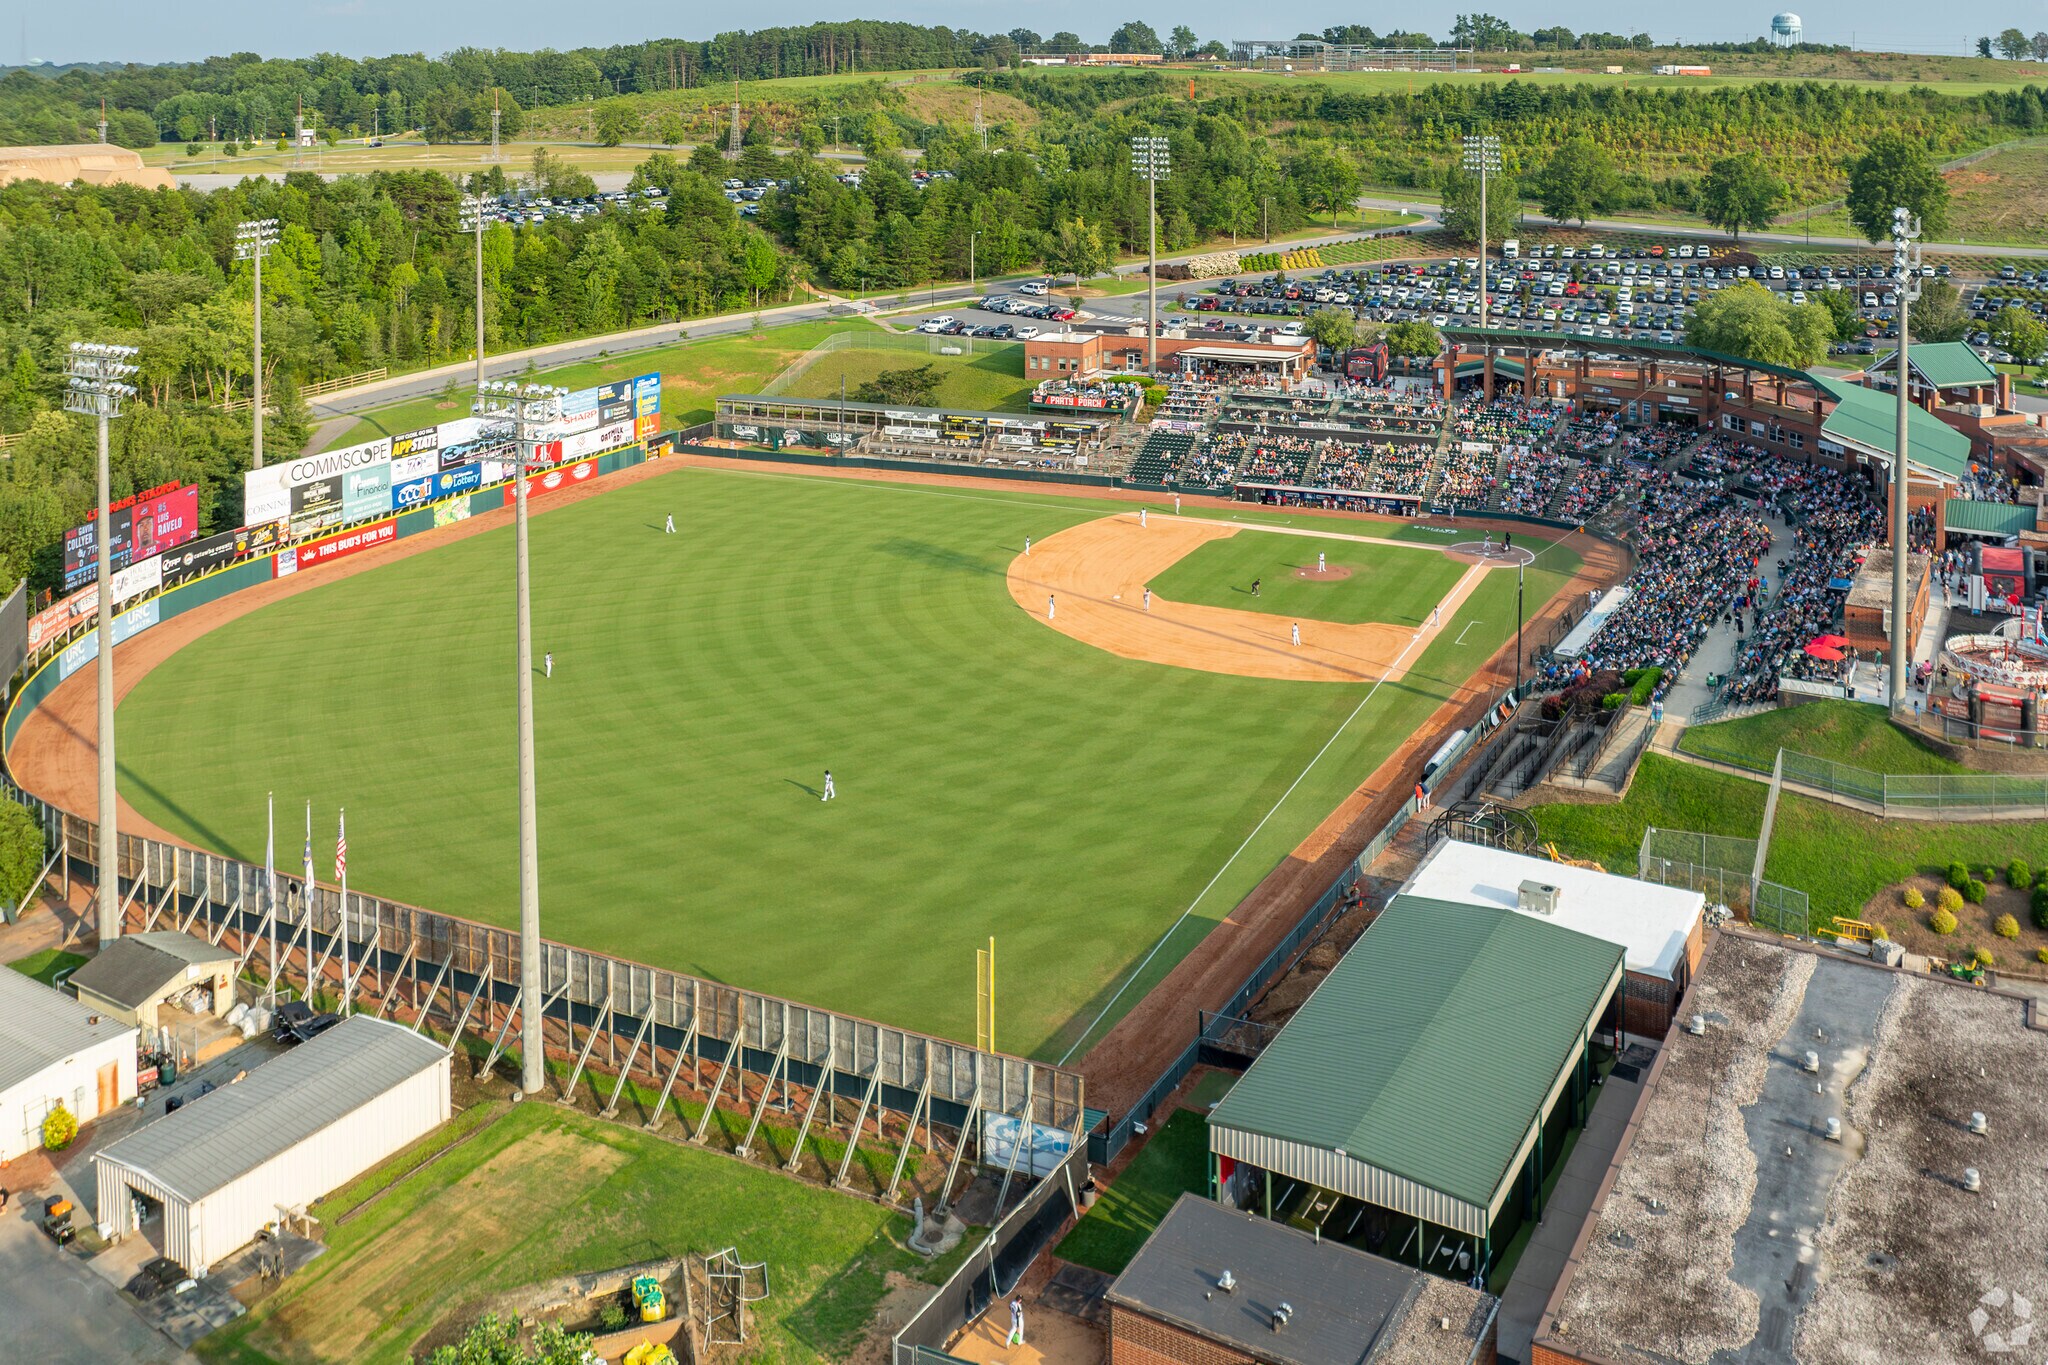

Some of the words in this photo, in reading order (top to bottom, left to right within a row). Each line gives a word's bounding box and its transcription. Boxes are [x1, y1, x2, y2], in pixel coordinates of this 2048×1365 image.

[1050, 396, 1074, 405] PARTY
[1078, 398, 1102, 407] PORCH
[563, 410, 597, 424] SHARP
[600, 426, 624, 442] OATMILK
[733, 424, 758, 433] HICKORY
[291, 442, 388, 481] COMMSCOPE
[453, 472, 480, 487] Lottery
[138, 480, 180, 502] STADIUM
[357, 481, 388, 497] Financial
[246, 498, 290, 517] CORNING
[158, 512, 169, 523] LUIS
[78, 523, 94, 535] GAVIN
[158, 517, 182, 536] RAVELO
[67, 533, 93, 551] COLLYER
[319, 542, 337, 557] THIS
[337, 535, 361, 552] BUD'S
[362, 529, 377, 543] FOR
[378, 525, 394, 538] YOU
[194, 547, 214, 559] catawba
[215, 542, 234, 553] county
[127, 604, 150, 625] UNC
[66, 640, 85, 661] UNC
